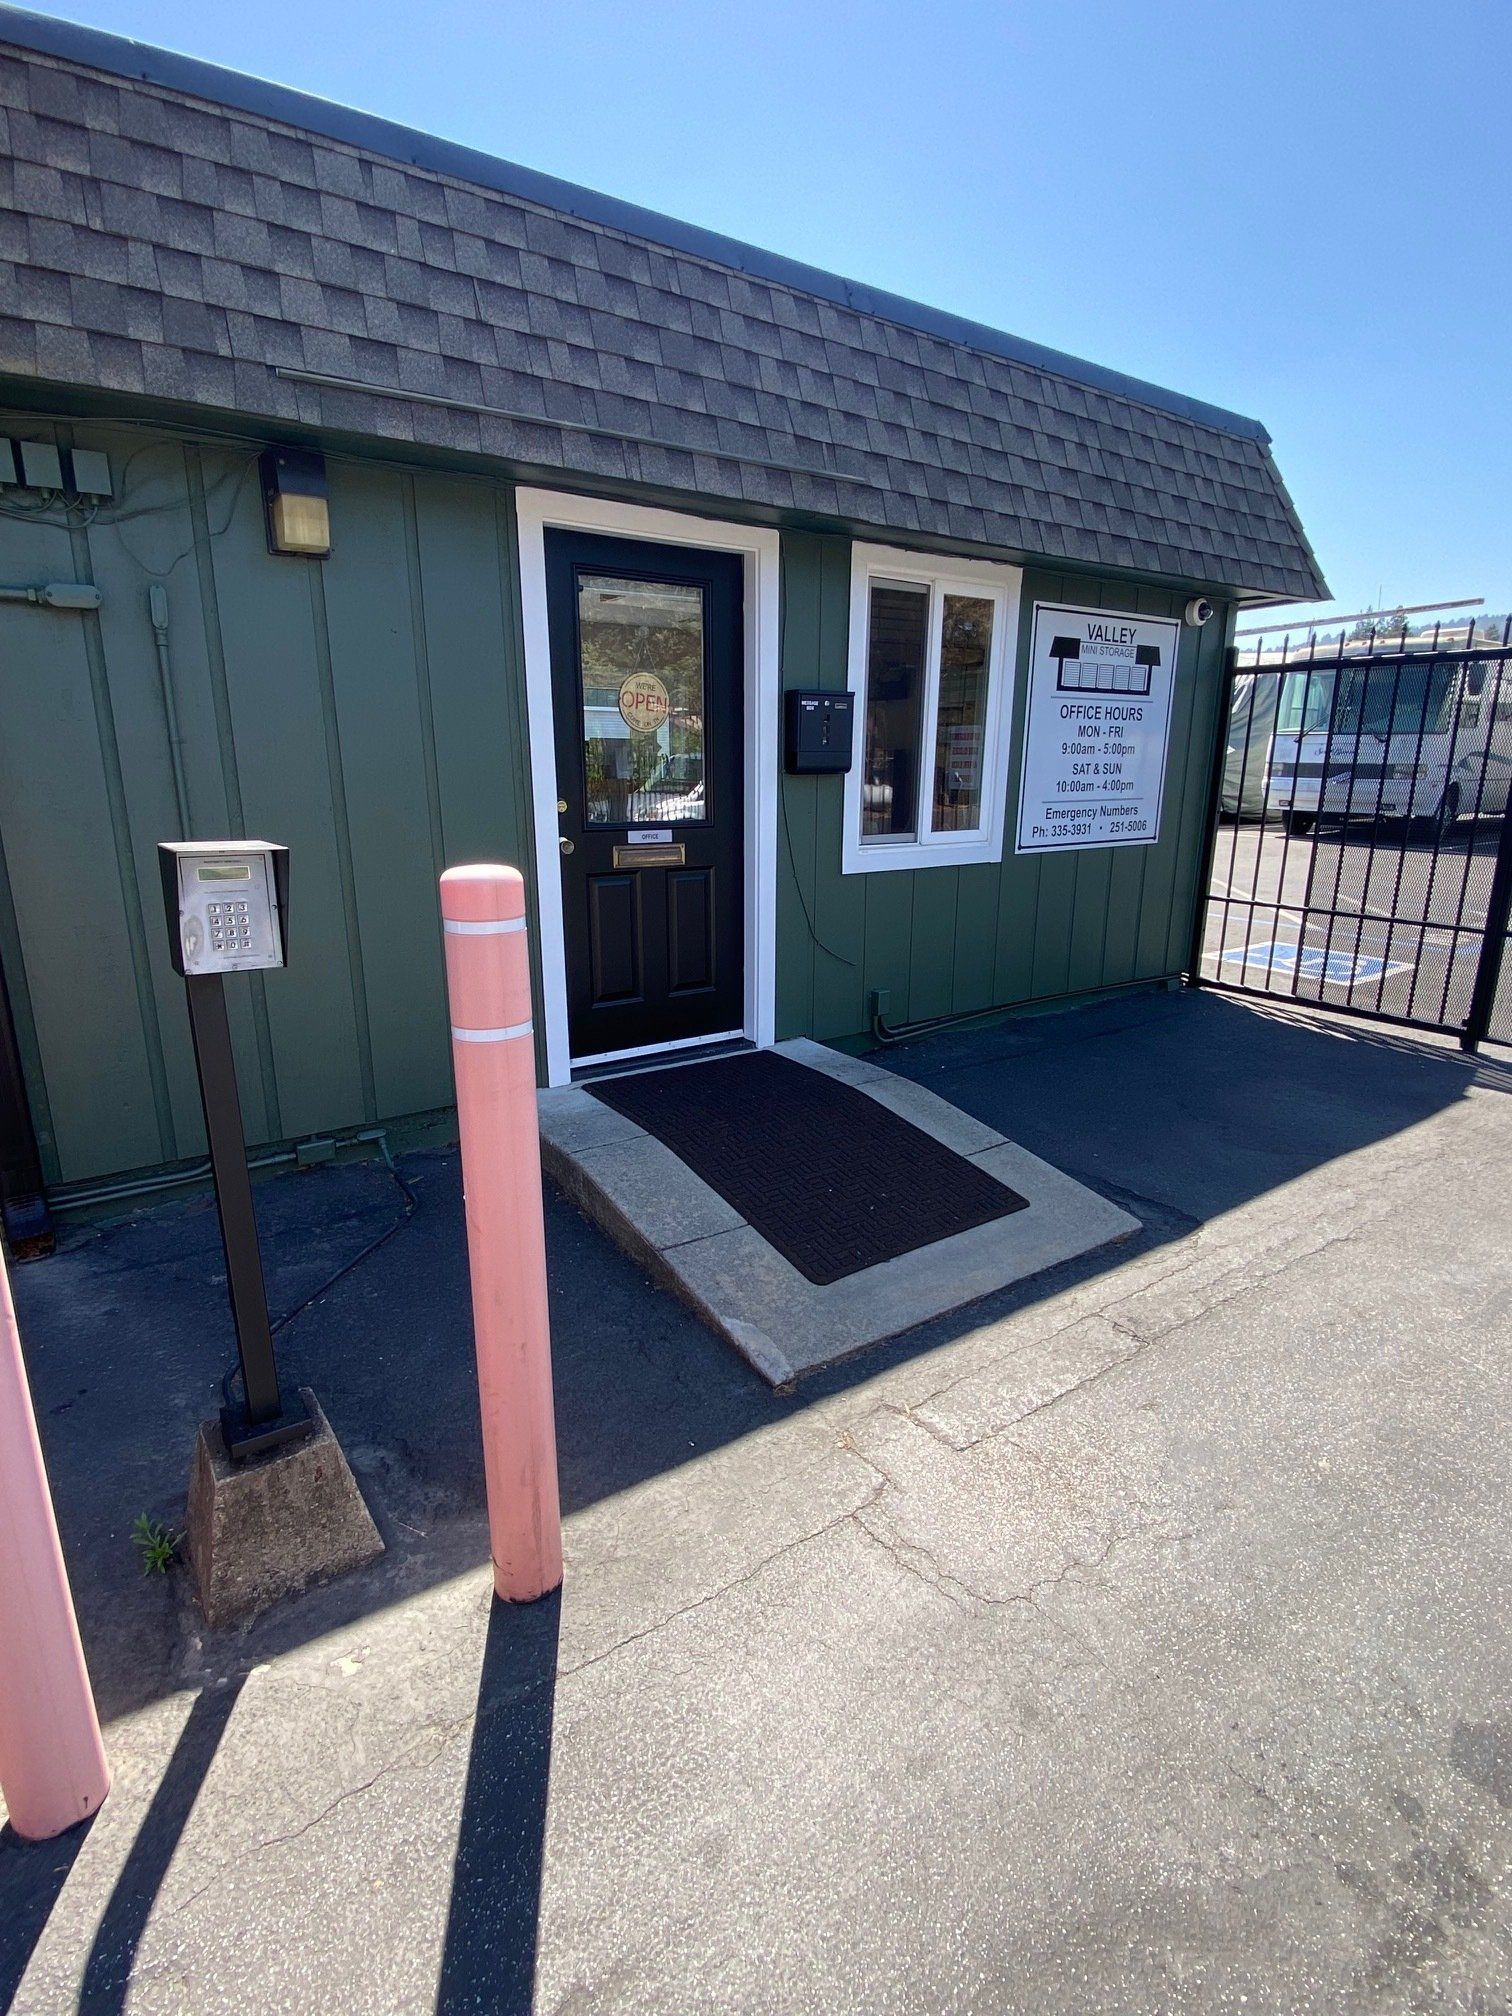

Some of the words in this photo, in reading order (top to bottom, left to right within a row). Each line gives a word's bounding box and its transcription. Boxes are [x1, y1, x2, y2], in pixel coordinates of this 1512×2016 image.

[1088, 623, 1137, 644] VALLEY
[1081, 644, 1098, 655] MINI
[1099, 646, 1135, 658] STORAGE
[622, 691, 667, 713] OPEN
[1060, 705, 1102, 720] OFFICE
[1105, 706, 1144, 721] HOURS
[1078, 725, 1101, 738] MON
[1108, 726, 1124, 738] FRI
[1061, 742, 1095, 755] 9:00am
[1103, 743, 1135, 757] 5:00pm
[1072, 763, 1091, 775] SAT
[1093, 763, 1100, 775] &
[1102, 763, 1123, 775] SUN
[1056, 780, 1095, 793] 10:00am
[1102, 779, 1134, 793] 4:00pm
[1045, 807, 1097, 821] Emergency
[1100, 805, 1138, 817] Numbers
[1032, 826, 1048, 838] Ph:
[1051, 823, 1091, 837] 335-3931
[1110, 820, 1147, 833] 251-5006
